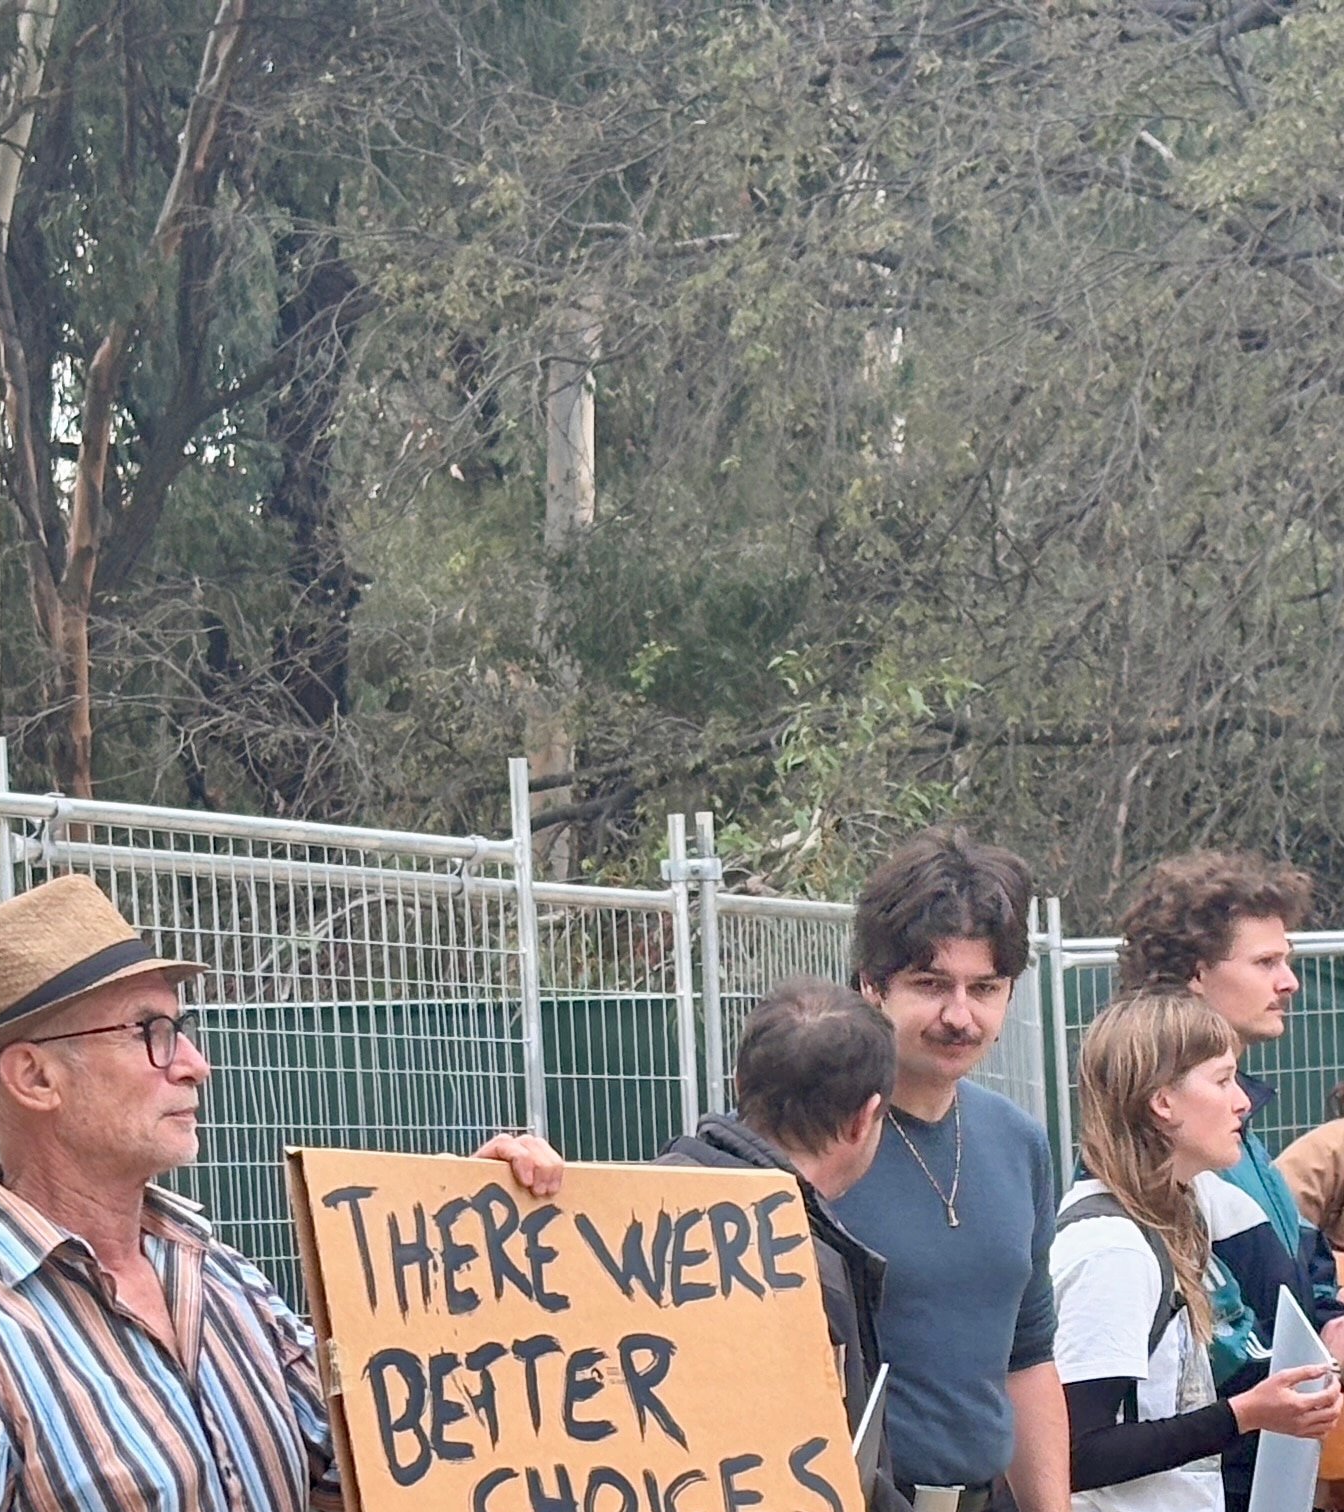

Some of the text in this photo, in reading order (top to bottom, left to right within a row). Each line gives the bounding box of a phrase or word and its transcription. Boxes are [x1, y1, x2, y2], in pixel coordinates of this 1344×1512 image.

[322, 1182, 808, 1323] THERE WERE
[362, 1333, 690, 1487] BETTER
